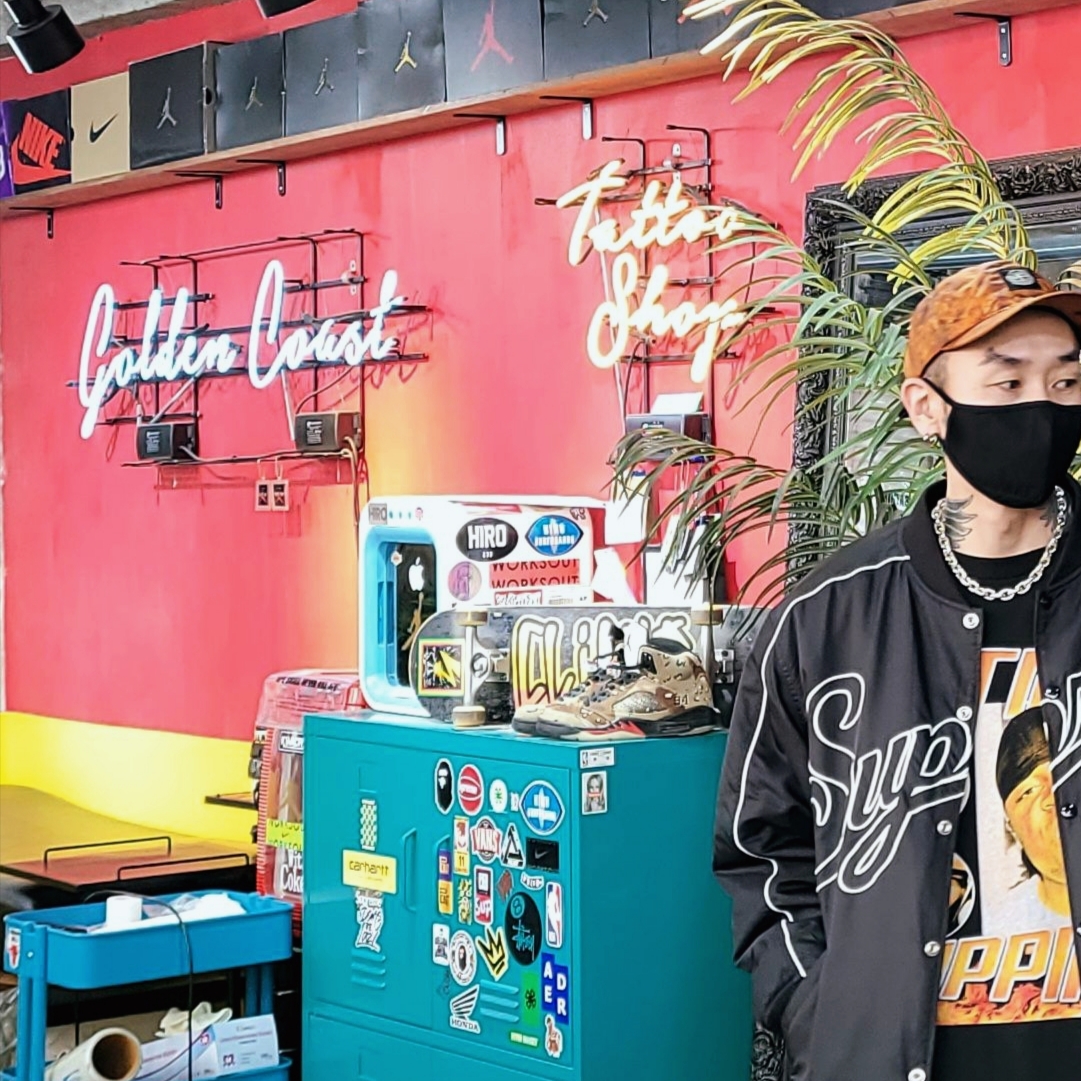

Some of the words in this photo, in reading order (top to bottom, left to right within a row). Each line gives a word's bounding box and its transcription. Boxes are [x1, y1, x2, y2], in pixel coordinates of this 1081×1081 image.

[19, 111, 65, 169] NIKE
[556, 158, 745, 266] Tattoo
[587, 252, 747, 383] Shop
[79, 283, 237, 439] Golden
[249, 259, 403, 388] Coast
[467, 523, 507, 549] HIRO
[280, 864, 304, 893] Cok
[349, 860, 390, 877] carhartt
[451, 1018, 479, 1032] HONDA
